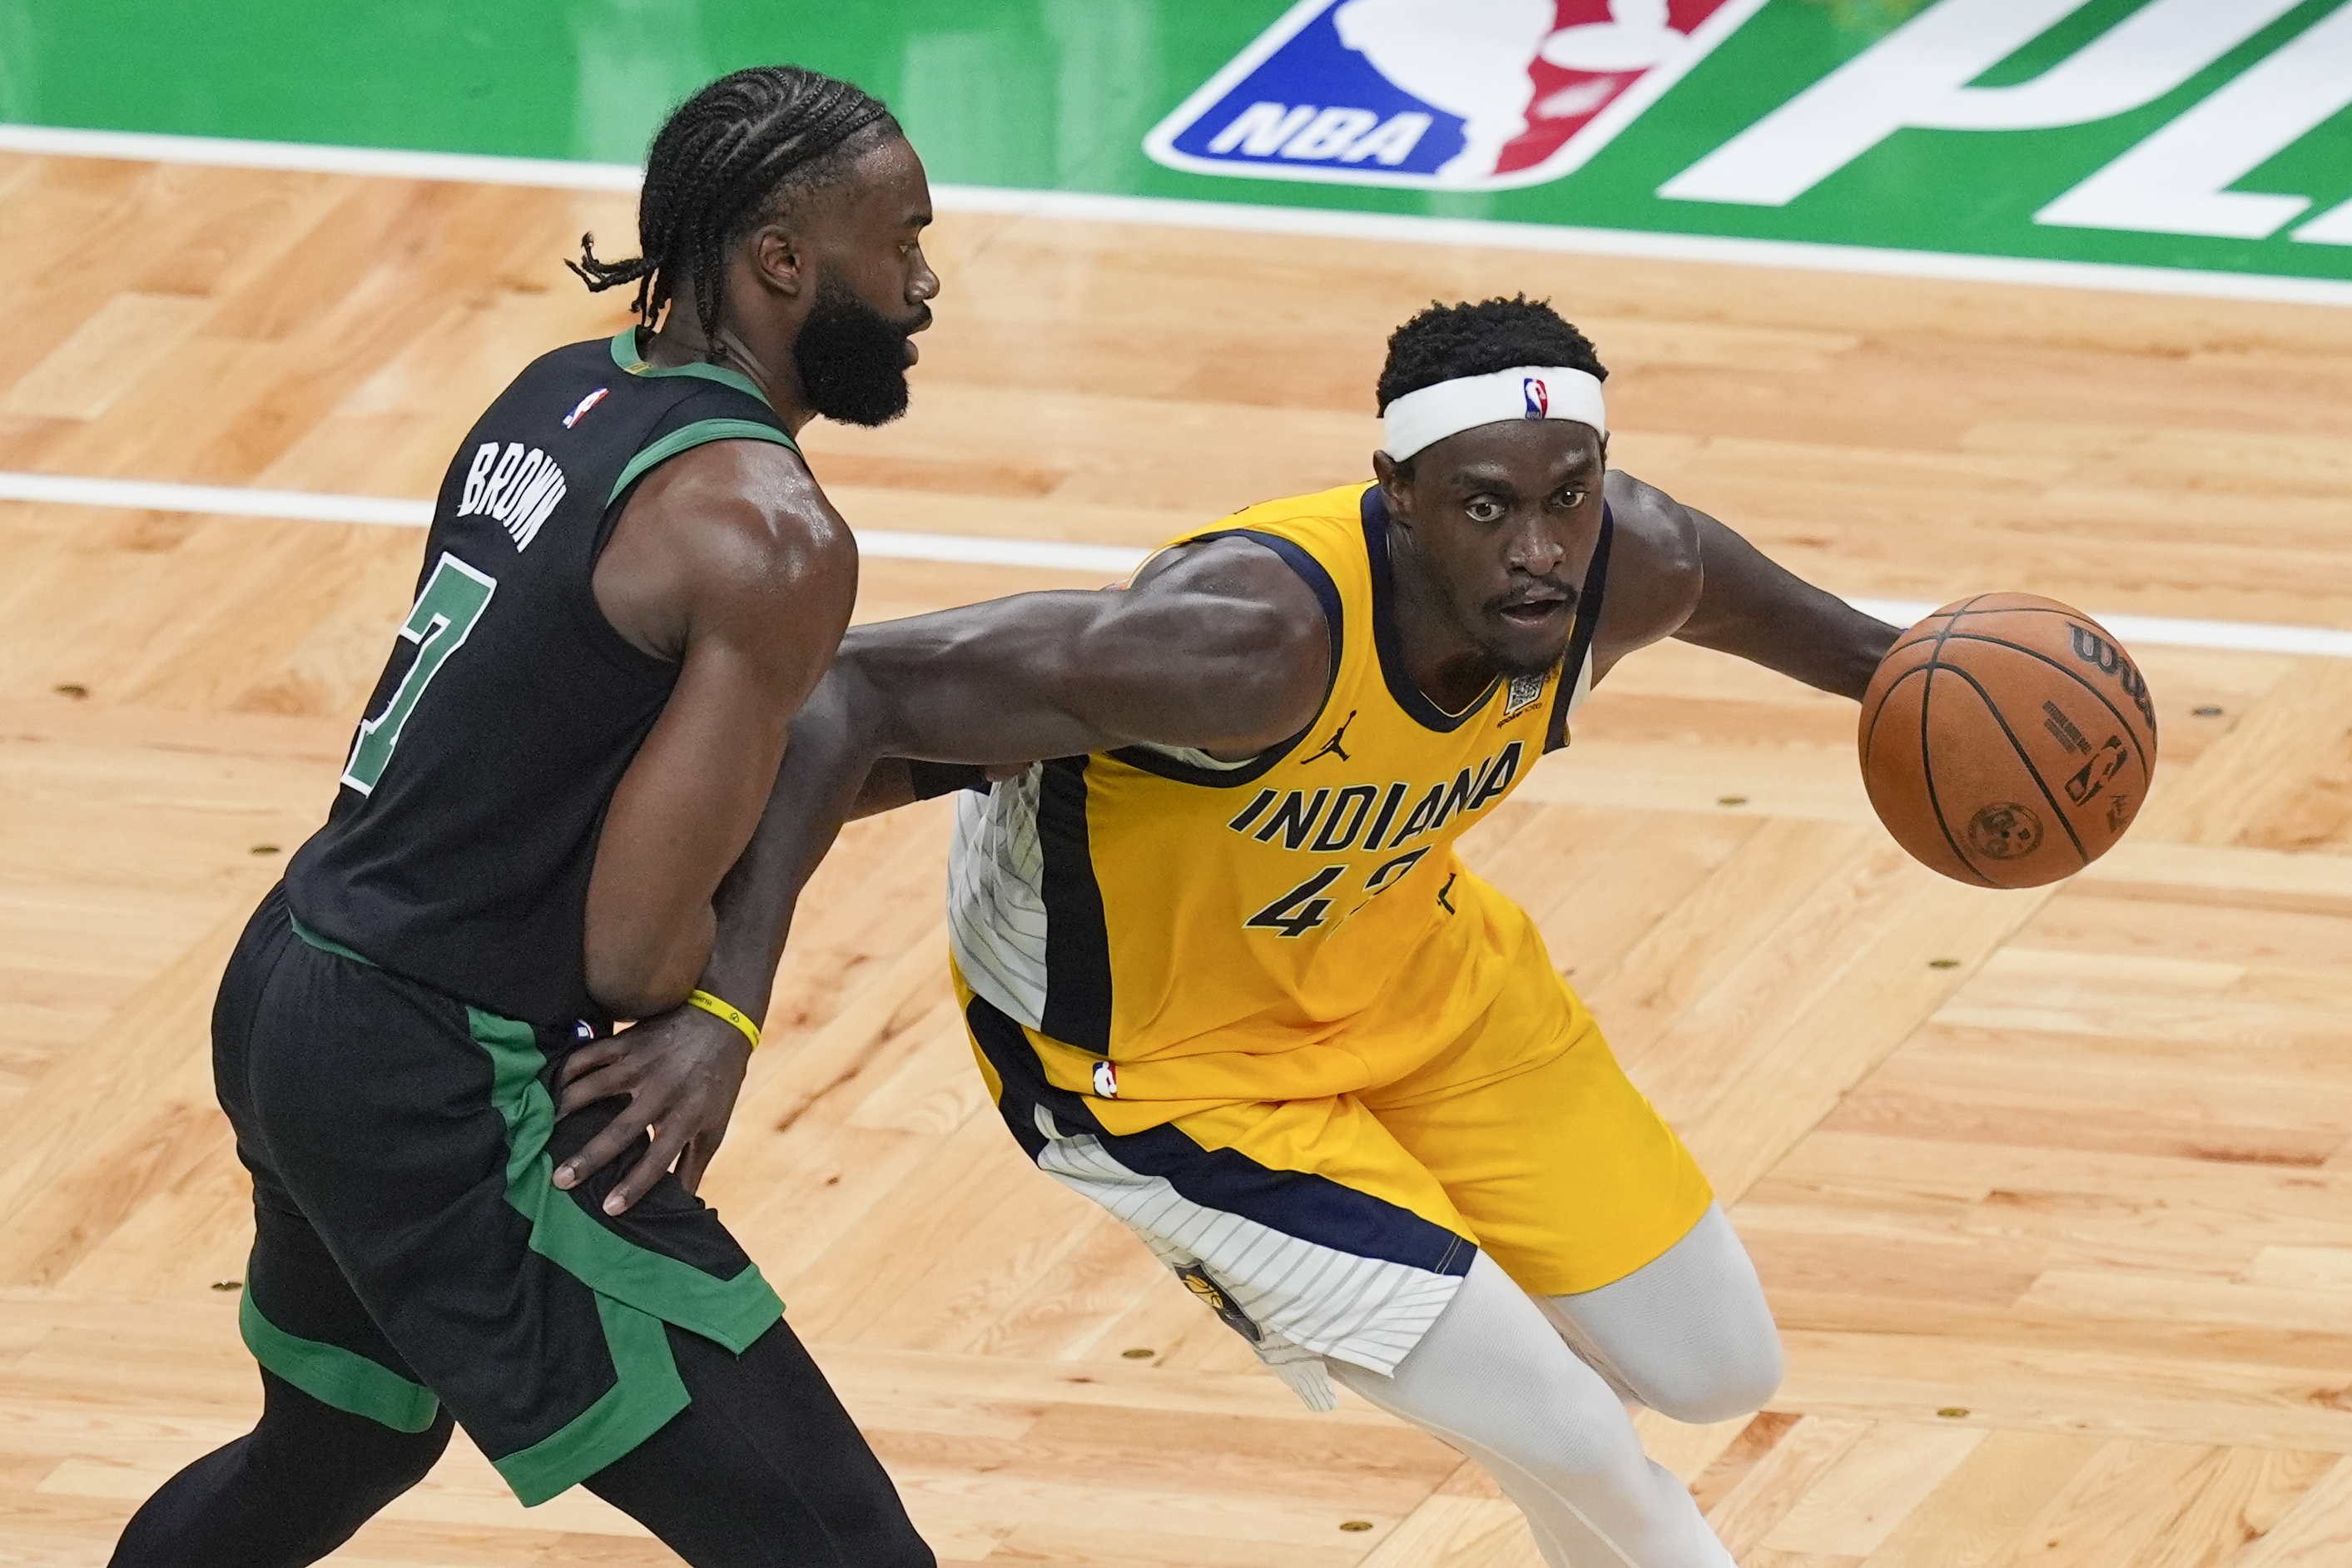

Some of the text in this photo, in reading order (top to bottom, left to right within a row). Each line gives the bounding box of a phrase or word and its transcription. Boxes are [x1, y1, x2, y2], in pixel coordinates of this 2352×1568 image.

[1207, 102, 1433, 166] NBA
[1655, 0, 2352, 246] PL
[457, 441, 567, 553] BROWN
[340, 551, 497, 798] 7
[1227, 740, 1525, 853] INDIANA
